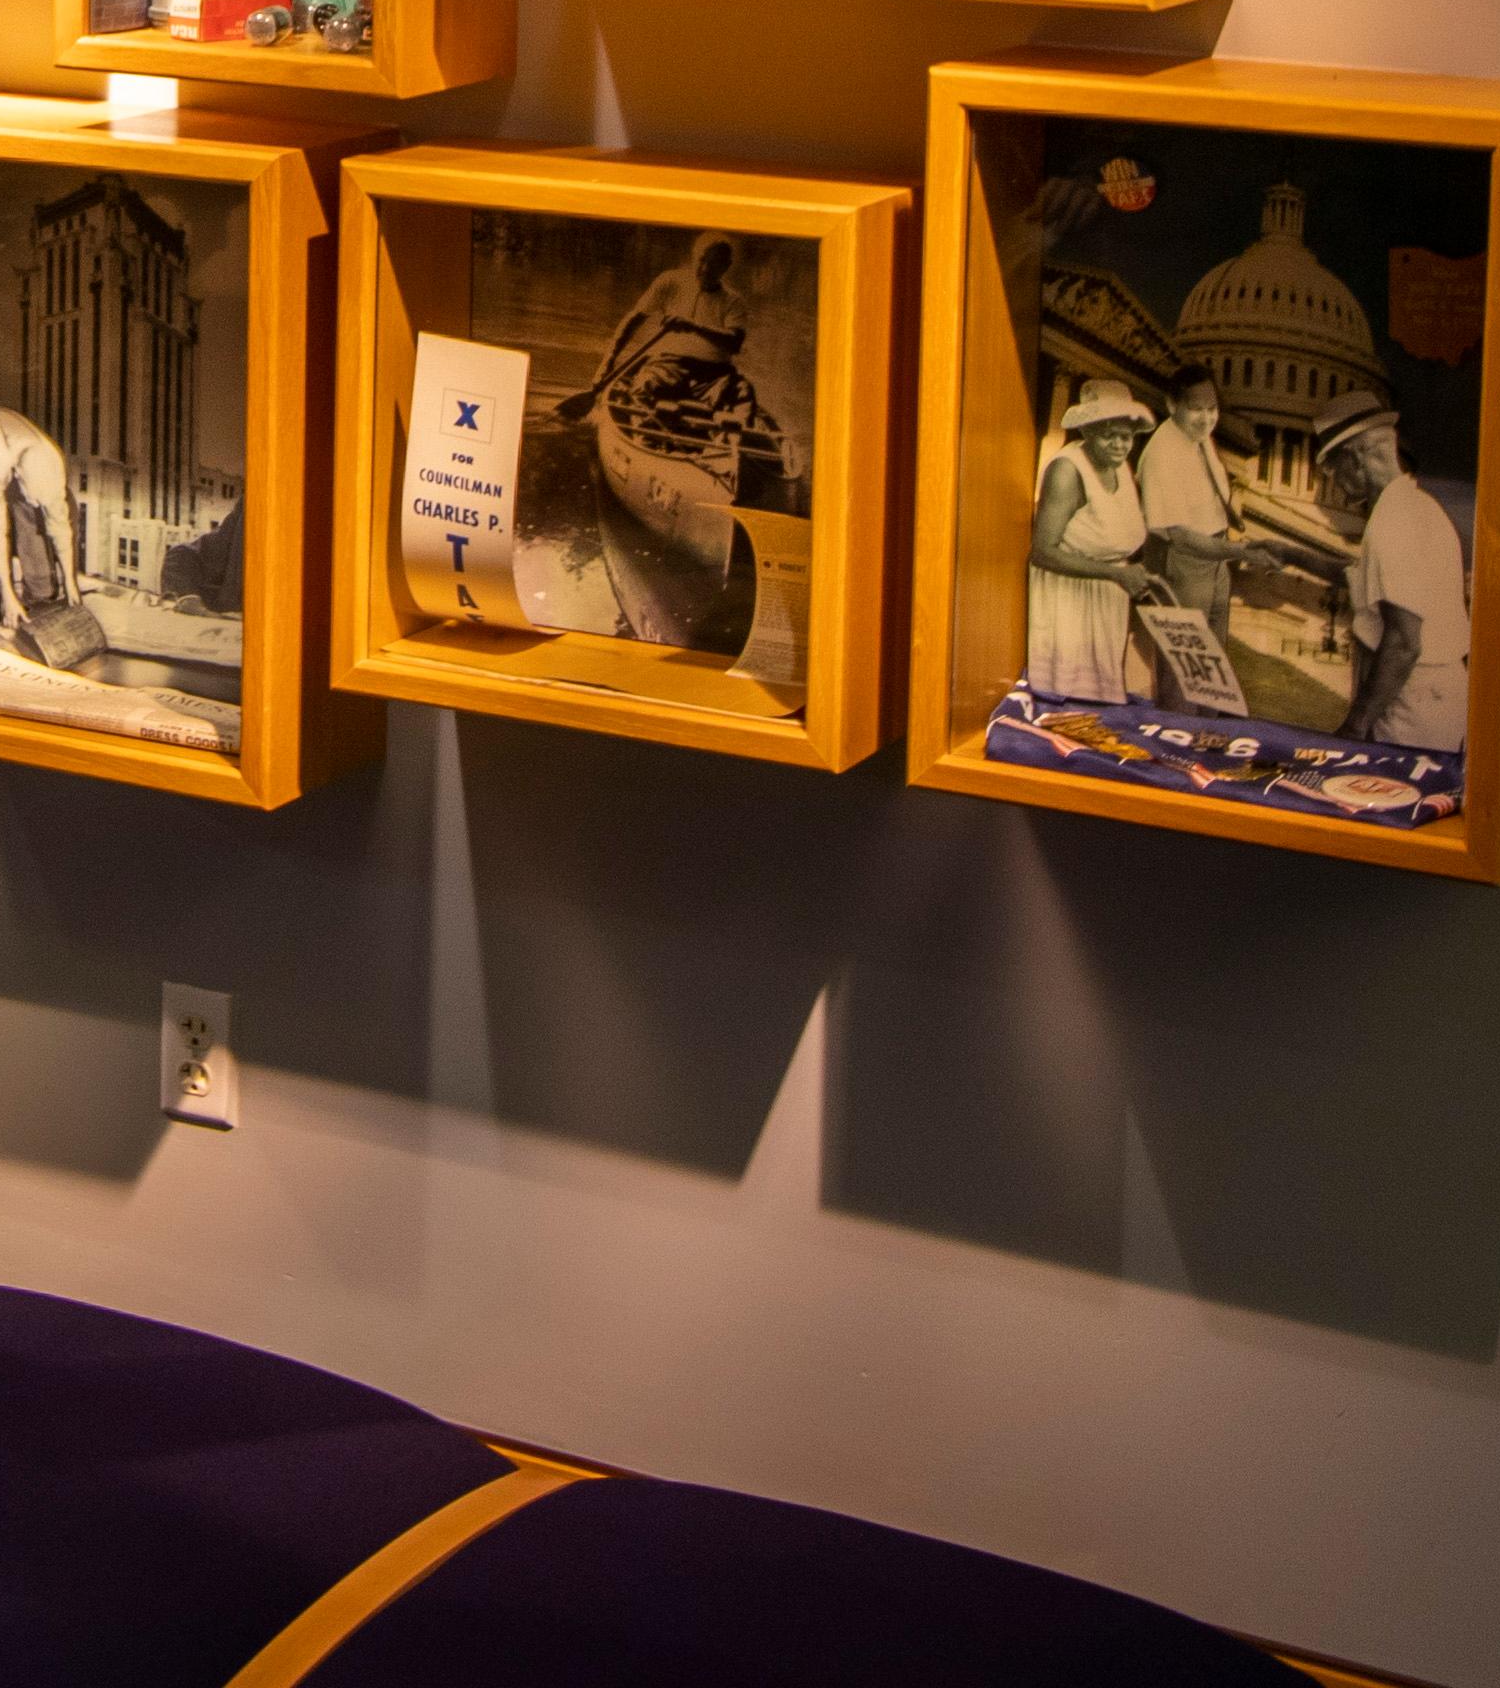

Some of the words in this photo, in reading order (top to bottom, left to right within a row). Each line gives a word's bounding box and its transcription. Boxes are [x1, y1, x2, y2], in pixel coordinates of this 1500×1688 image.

[453, 400, 481, 431] X
[451, 452, 474, 466] FOR
[419, 468, 503, 500] COUNCILMAN
[413, 497, 480, 529] CHARLES
[487, 515, 503, 534] P.
[1165, 631, 1207, 651] BOB
[1168, 649, 1228, 687] TAFT
[1138, 723, 1262, 758] 196
